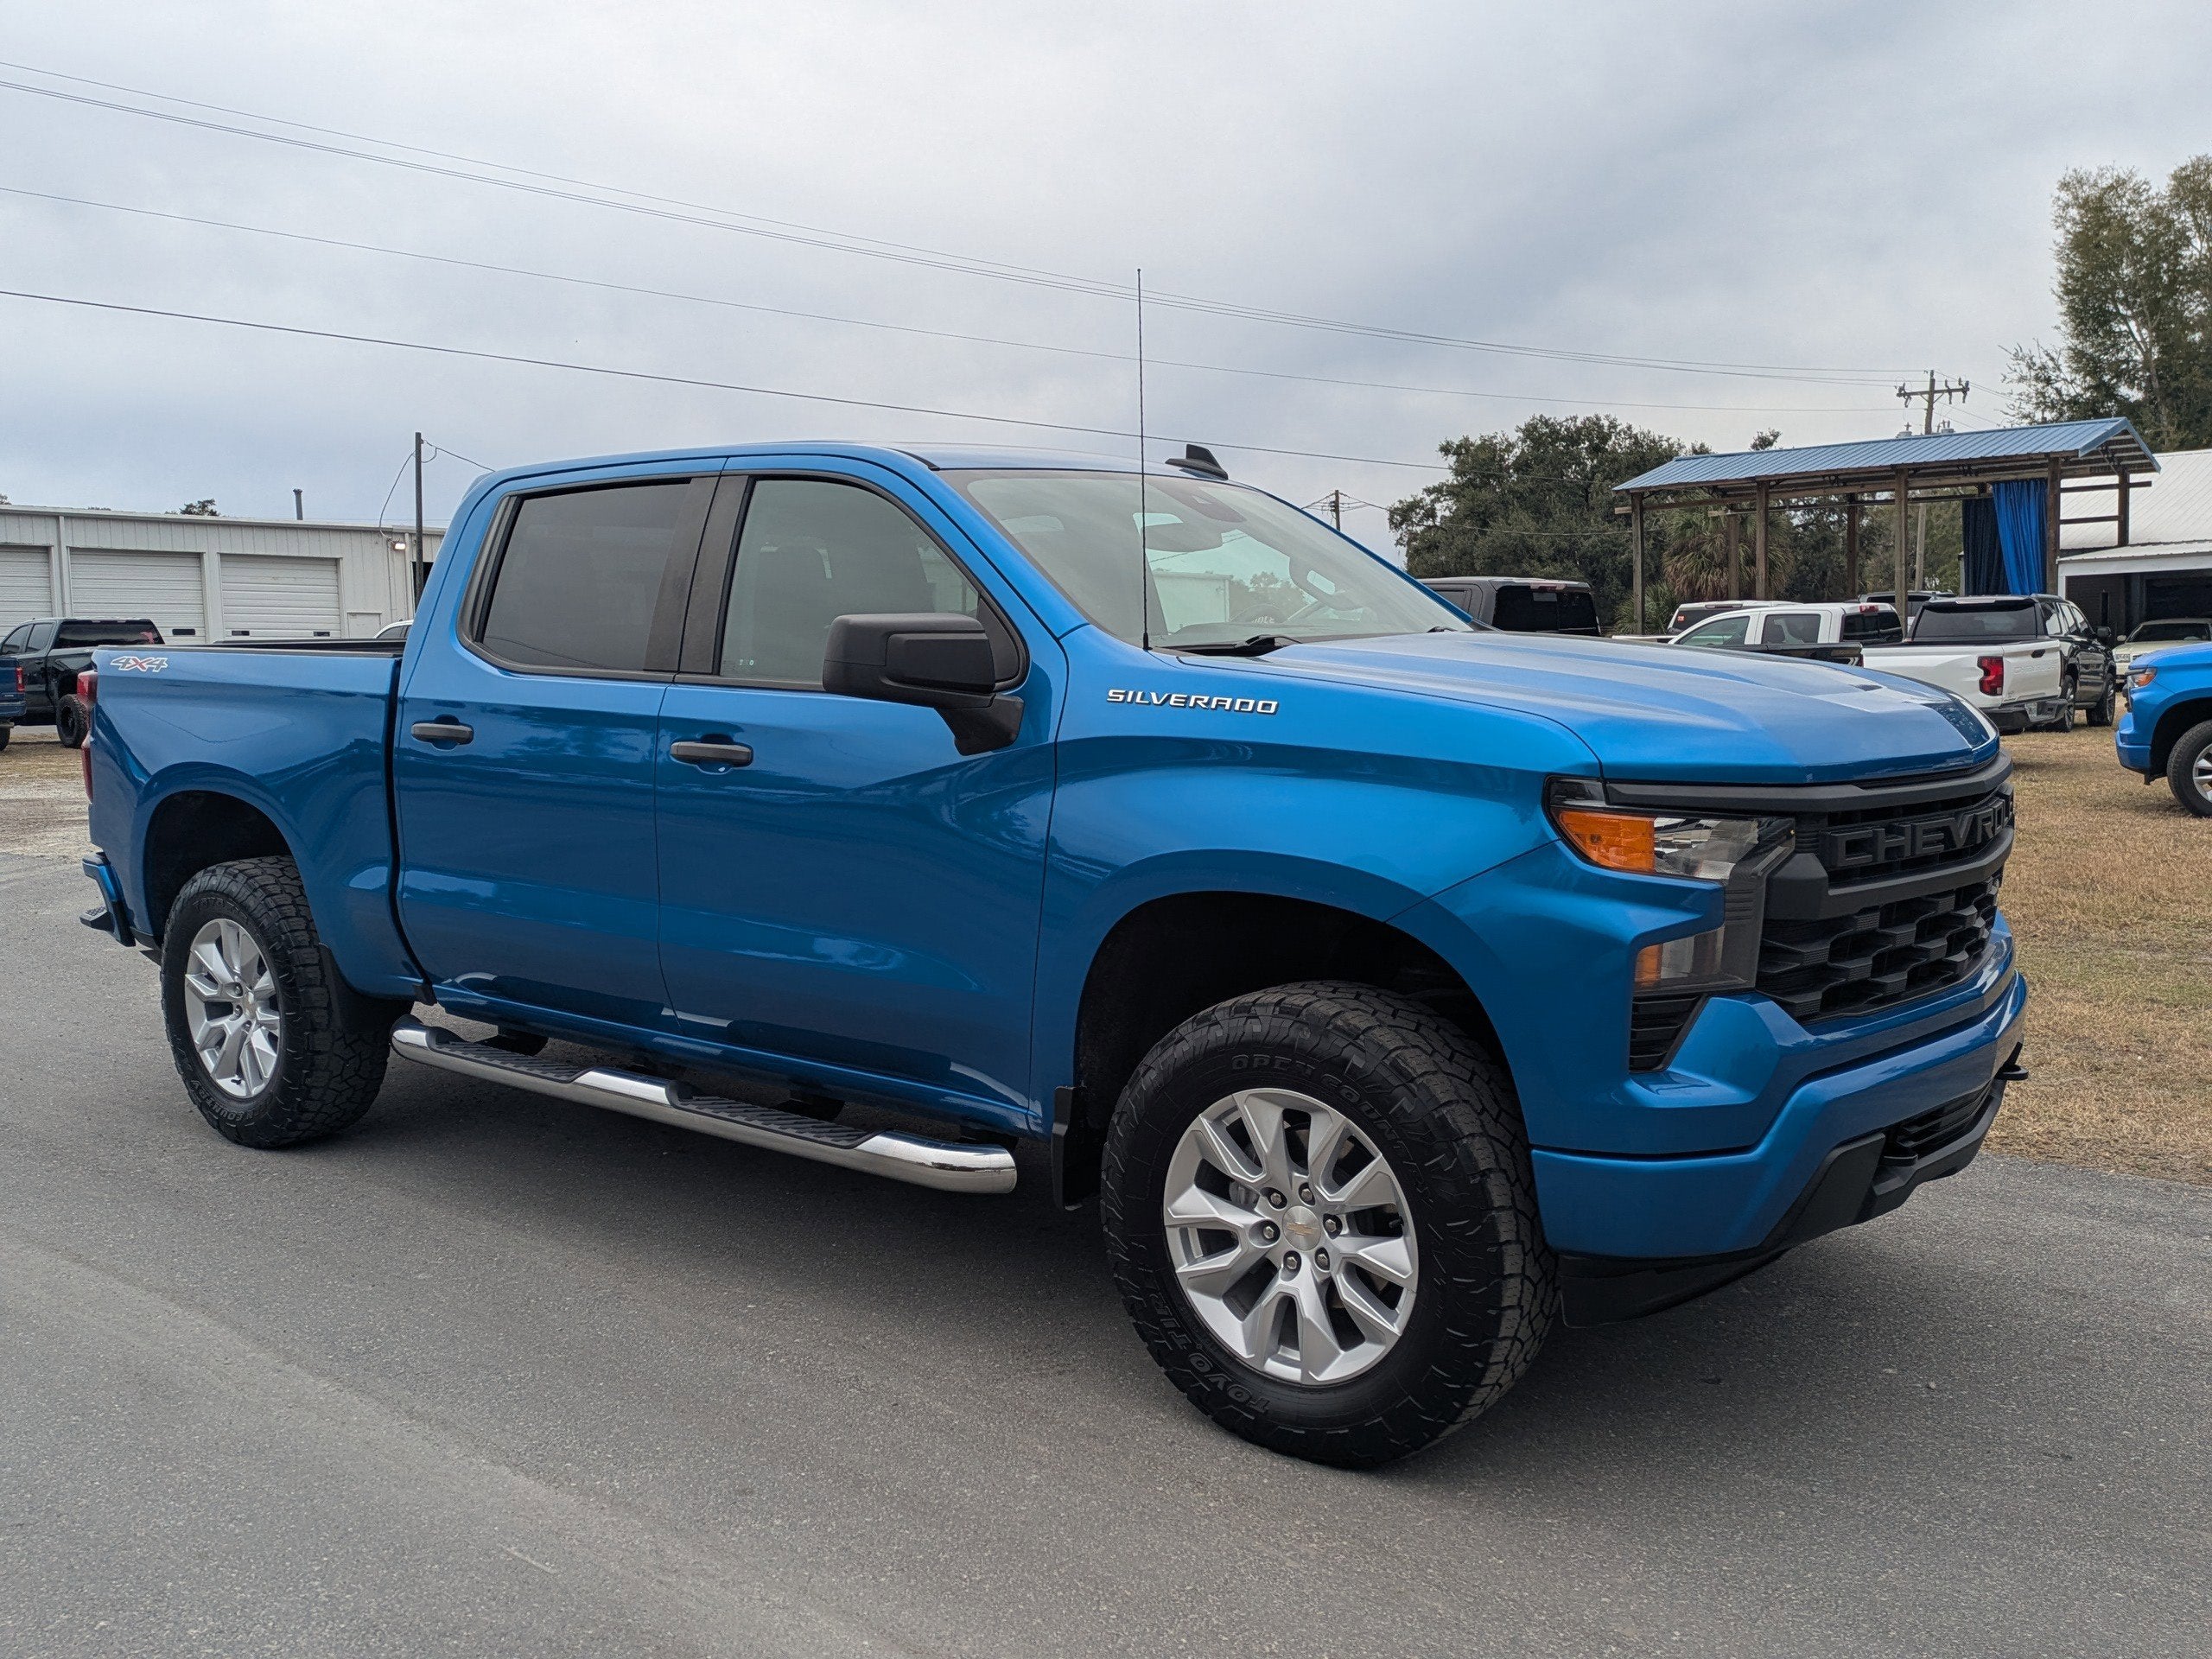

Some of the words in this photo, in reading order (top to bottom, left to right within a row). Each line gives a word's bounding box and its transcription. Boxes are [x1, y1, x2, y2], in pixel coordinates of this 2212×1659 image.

[1106, 689, 1279, 715] SILVERADO
[1829, 798, 2010, 866] CHEVRO
[1188, 1352, 1270, 1414] TOYO
